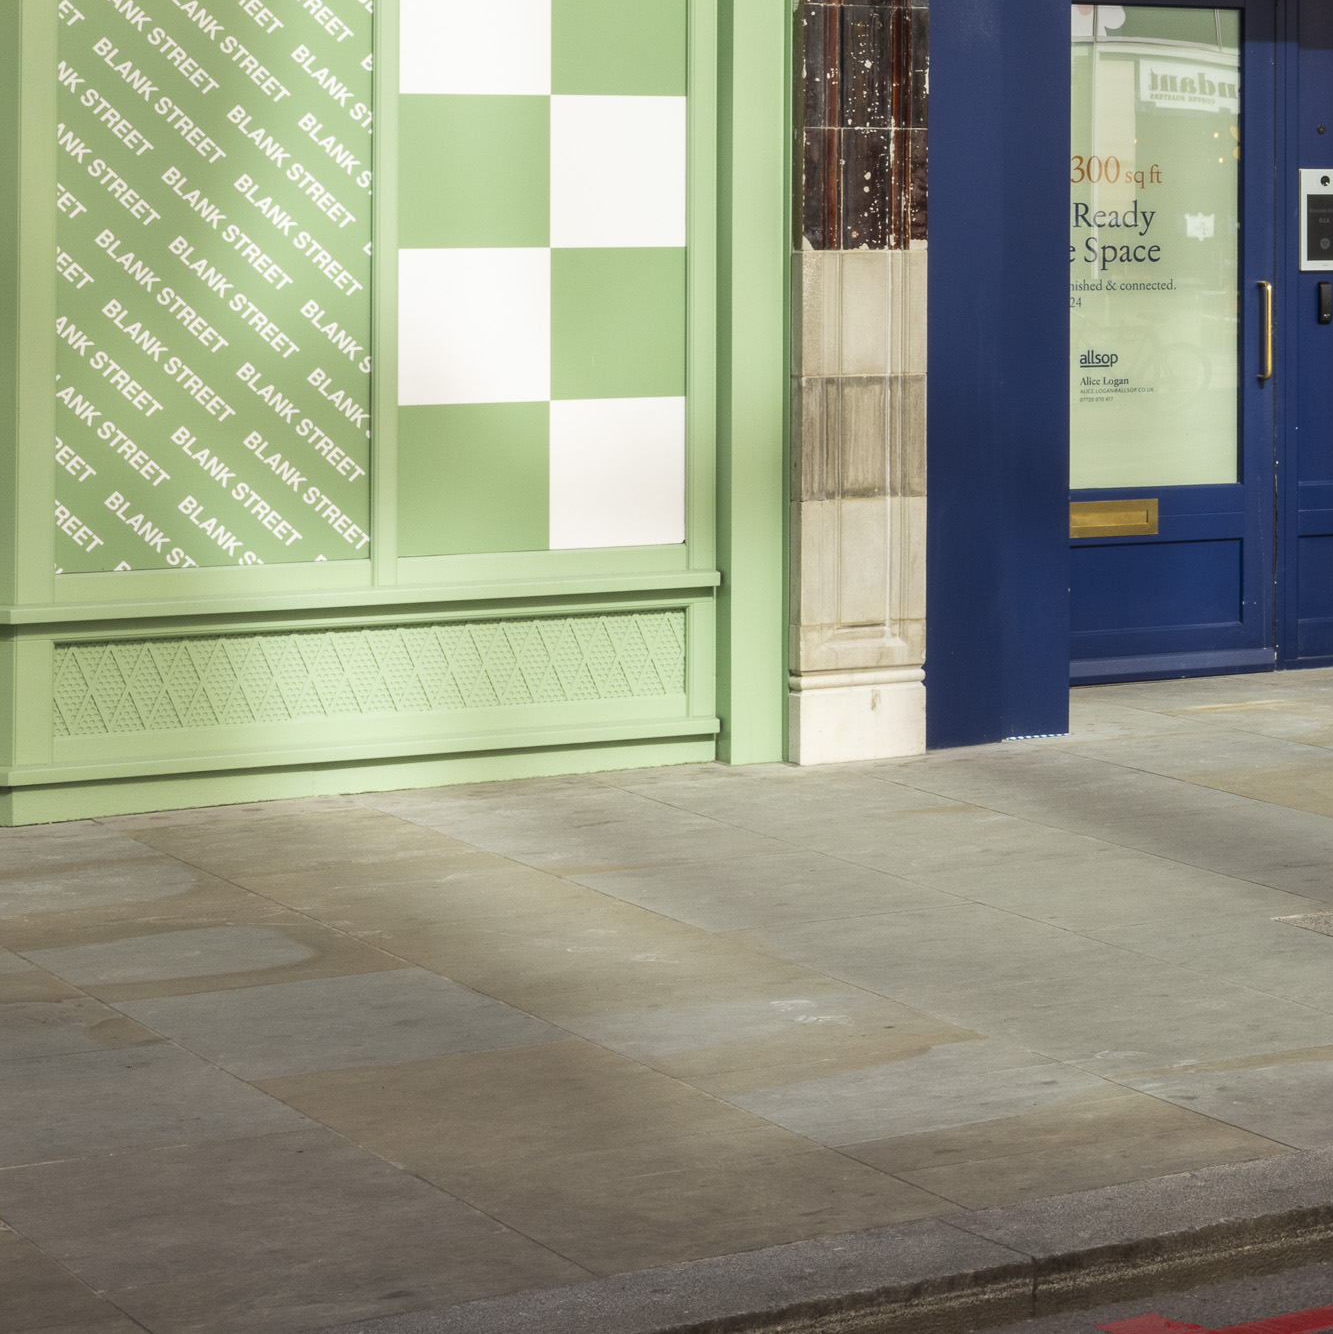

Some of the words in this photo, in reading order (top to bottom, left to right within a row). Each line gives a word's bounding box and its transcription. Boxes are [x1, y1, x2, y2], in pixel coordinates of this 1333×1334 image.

[147, 27, 219, 94] STREET
[220, 36, 291, 102] STREET
[291, 44, 354, 107] BLANK
[81, 89, 154, 155] STREET
[92, 37, 159, 101] BLANK
[154, 97, 226, 163] STREET
[227, 105, 291, 168] BLANK
[286, 163, 356, 228] STREET
[298, 112, 361, 175] BLANK
[1070, 155, 1120, 183] 300
[1125, 170, 1145, 189] sq
[1149, 164, 1162, 184] ft
[88, 159, 161, 225] STREET
[1073, 199, 1156, 236] Ready
[161, 166, 227, 229] BLANK
[222, 225, 293, 290] STREET
[234, 174, 298, 236] BLANK
[293, 231, 363, 296] STREET
[1084, 237, 1161, 271] Space
[95, 229, 161, 292] BLANK
[157, 287, 229, 353] STREET
[168, 236, 234, 298] BLANK
[229, 293, 300, 358] STREET
[1105, 280, 1116, 291] &
[1120, 278, 1177, 291] connected.
[102, 299, 168, 362] BLANK
[164, 357, 236, 421] STREET
[300, 299, 363, 361] BLANK
[1080, 350, 1118, 367] allsop
[90, 351, 163, 417] STREET
[307, 368, 369, 429] BLANK
[1080, 376, 1101, 386] Alice
[1103, 377, 1129, 387] Logan
[56, 374, 102, 426] ANK
[97, 421, 170, 486] STREET
[236, 362, 300, 424] BLANK
[296, 419, 365, 482] STREET
[56, 436, 96, 482] EET
[171, 426, 236, 488] BLANK
[232, 482, 302, 546] STREET
[243, 431, 307, 492] BLANK
[303, 487, 369, 549] STREET
[104, 491, 171, 553] BLANK
[178, 495, 243, 557] BLANK
